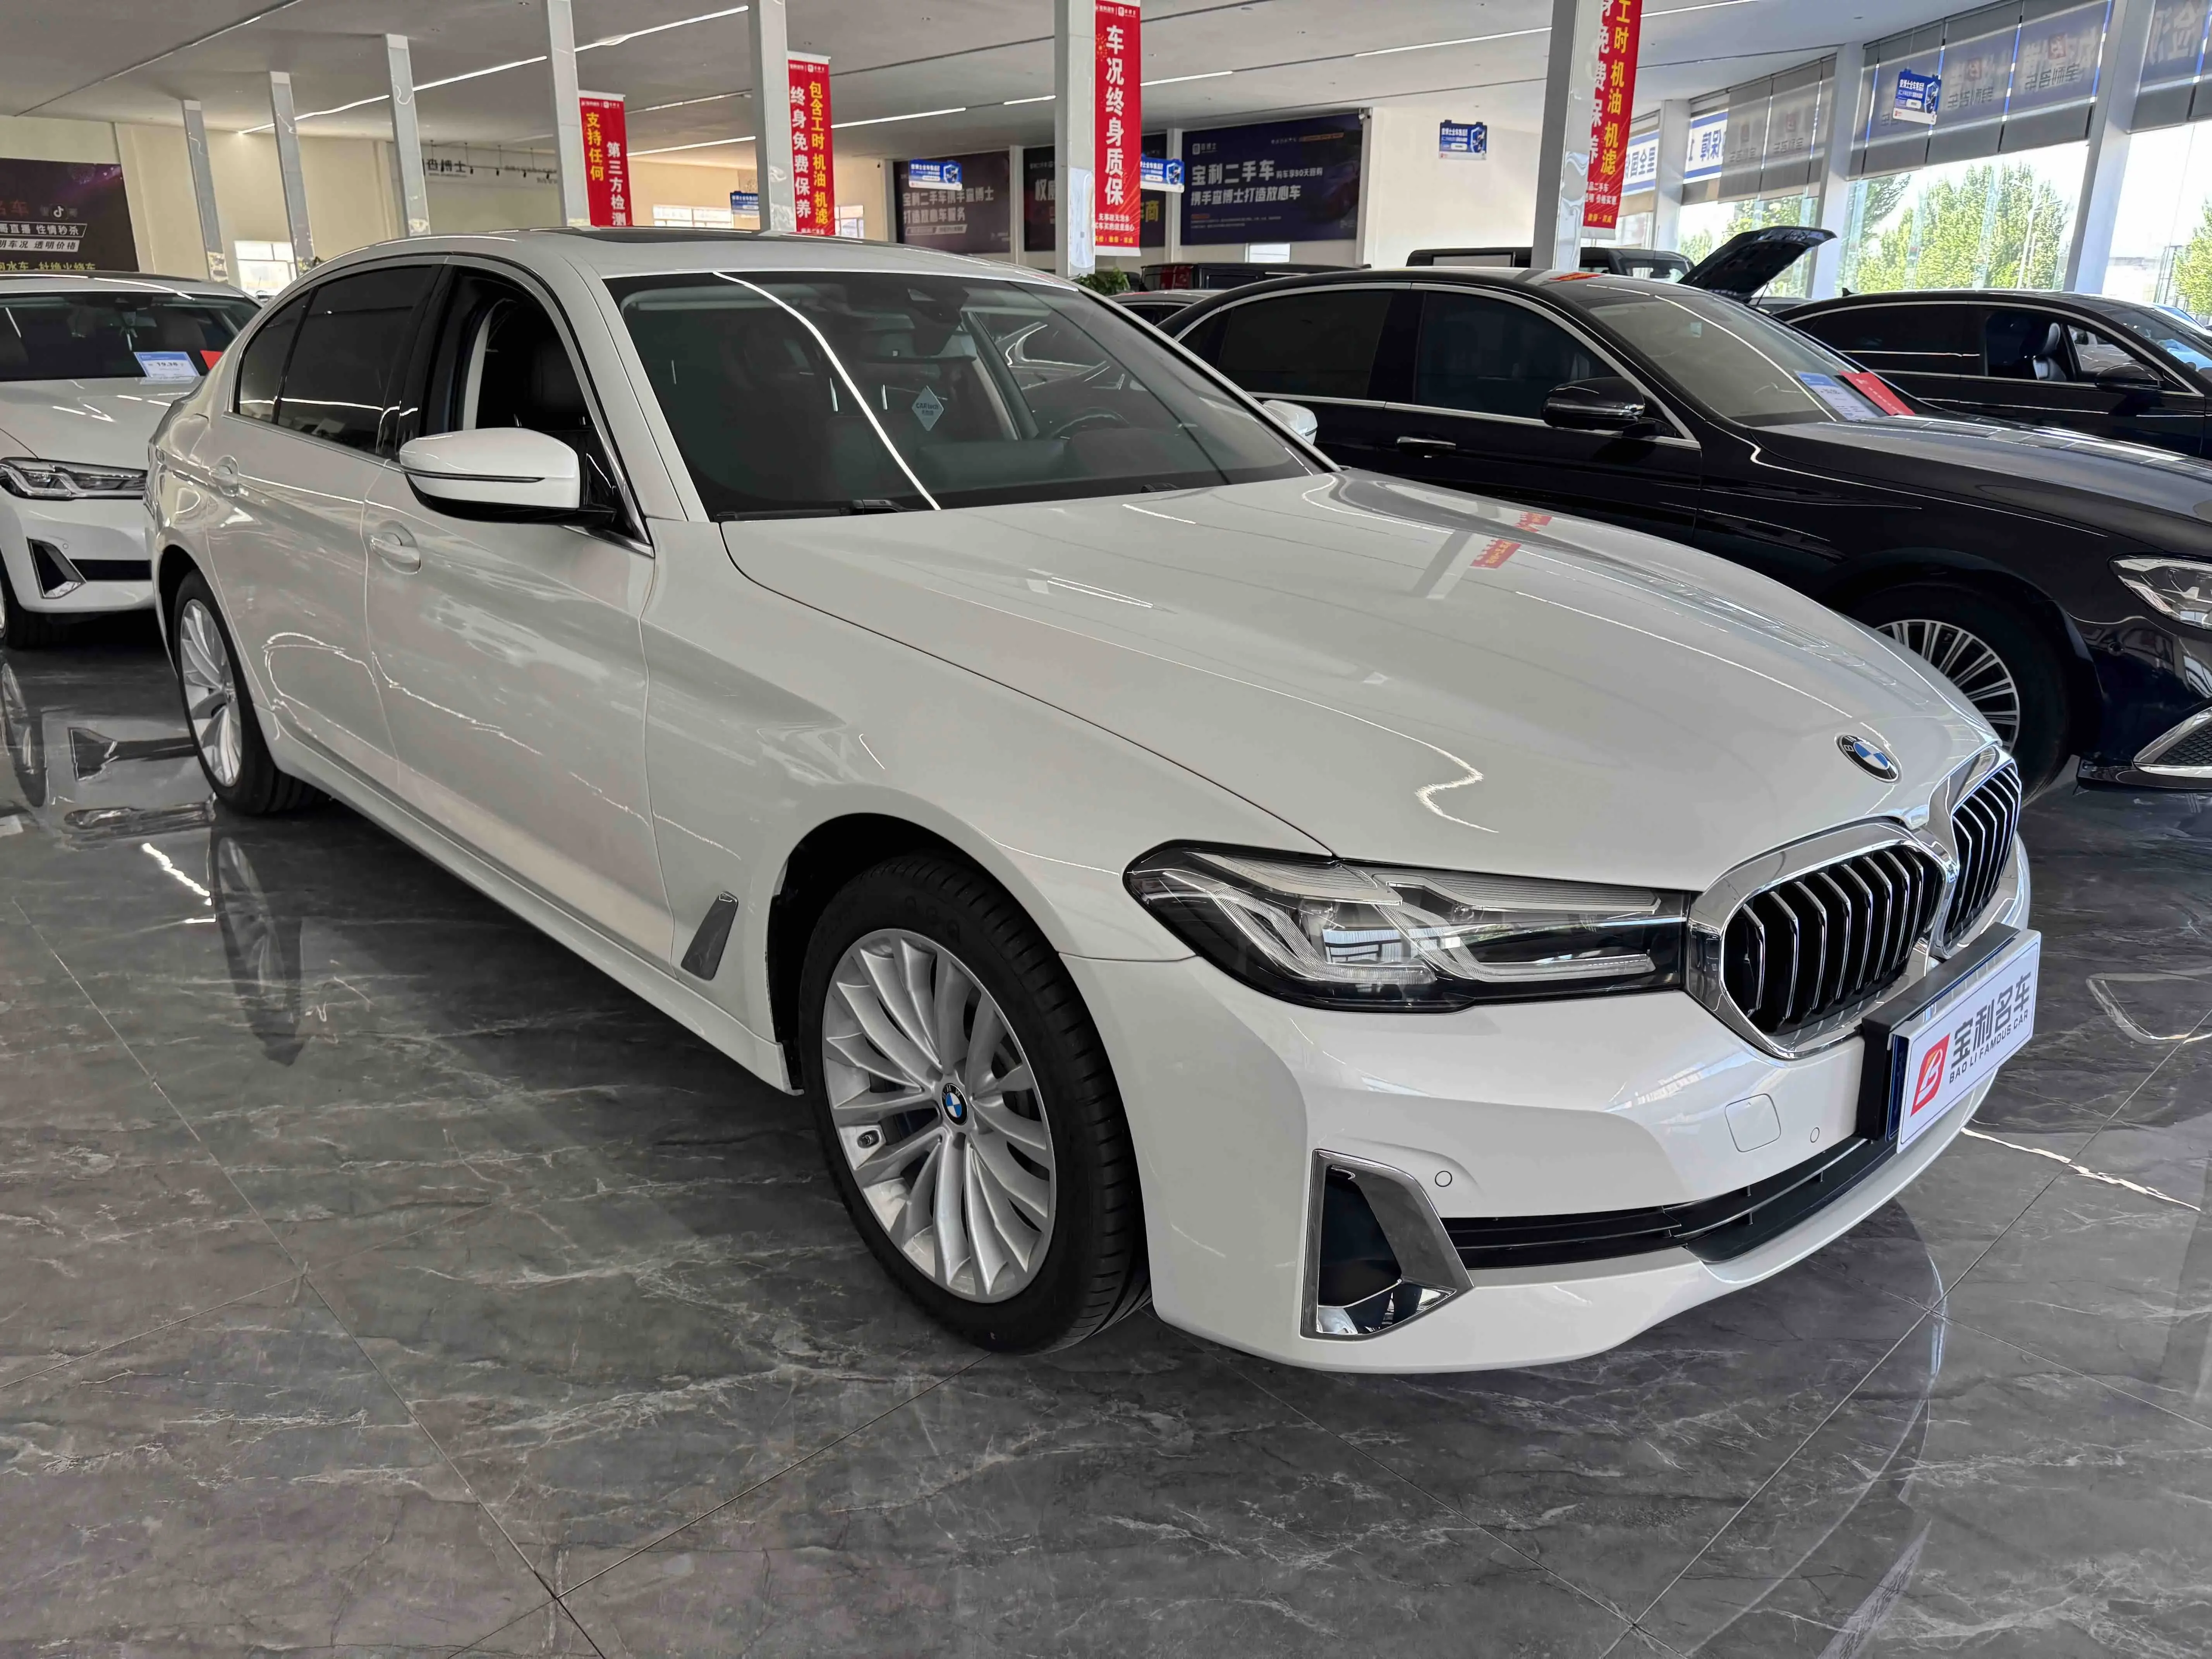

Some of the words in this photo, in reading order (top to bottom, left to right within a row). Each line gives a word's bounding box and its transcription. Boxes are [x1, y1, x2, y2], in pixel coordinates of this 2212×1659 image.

[809, 81, 825, 150] 包含工时
[1105, 24, 1125, 206] 车况终身质保
[1607, 59, 1625, 115] 机油
[586, 112, 604, 181] 支持任何
[790, 86, 811, 218] 终身免费保养
[812, 153, 826, 187] 机油
[1192, 160, 1274, 186] 宝利二手车
[1601, 121, 1618, 175] 机滤
[607, 141, 627, 226] 第三方检测
[814, 191, 828, 225] 机滤
[1949, 1062, 1968, 1084] BAO
[1970, 1053, 1977, 1066] LI
[1979, 1024, 2011, 1059] FAMOUS
[2013, 1008, 2028, 1032] CAR
[1951, 972, 2032, 1070] 宝利名车
